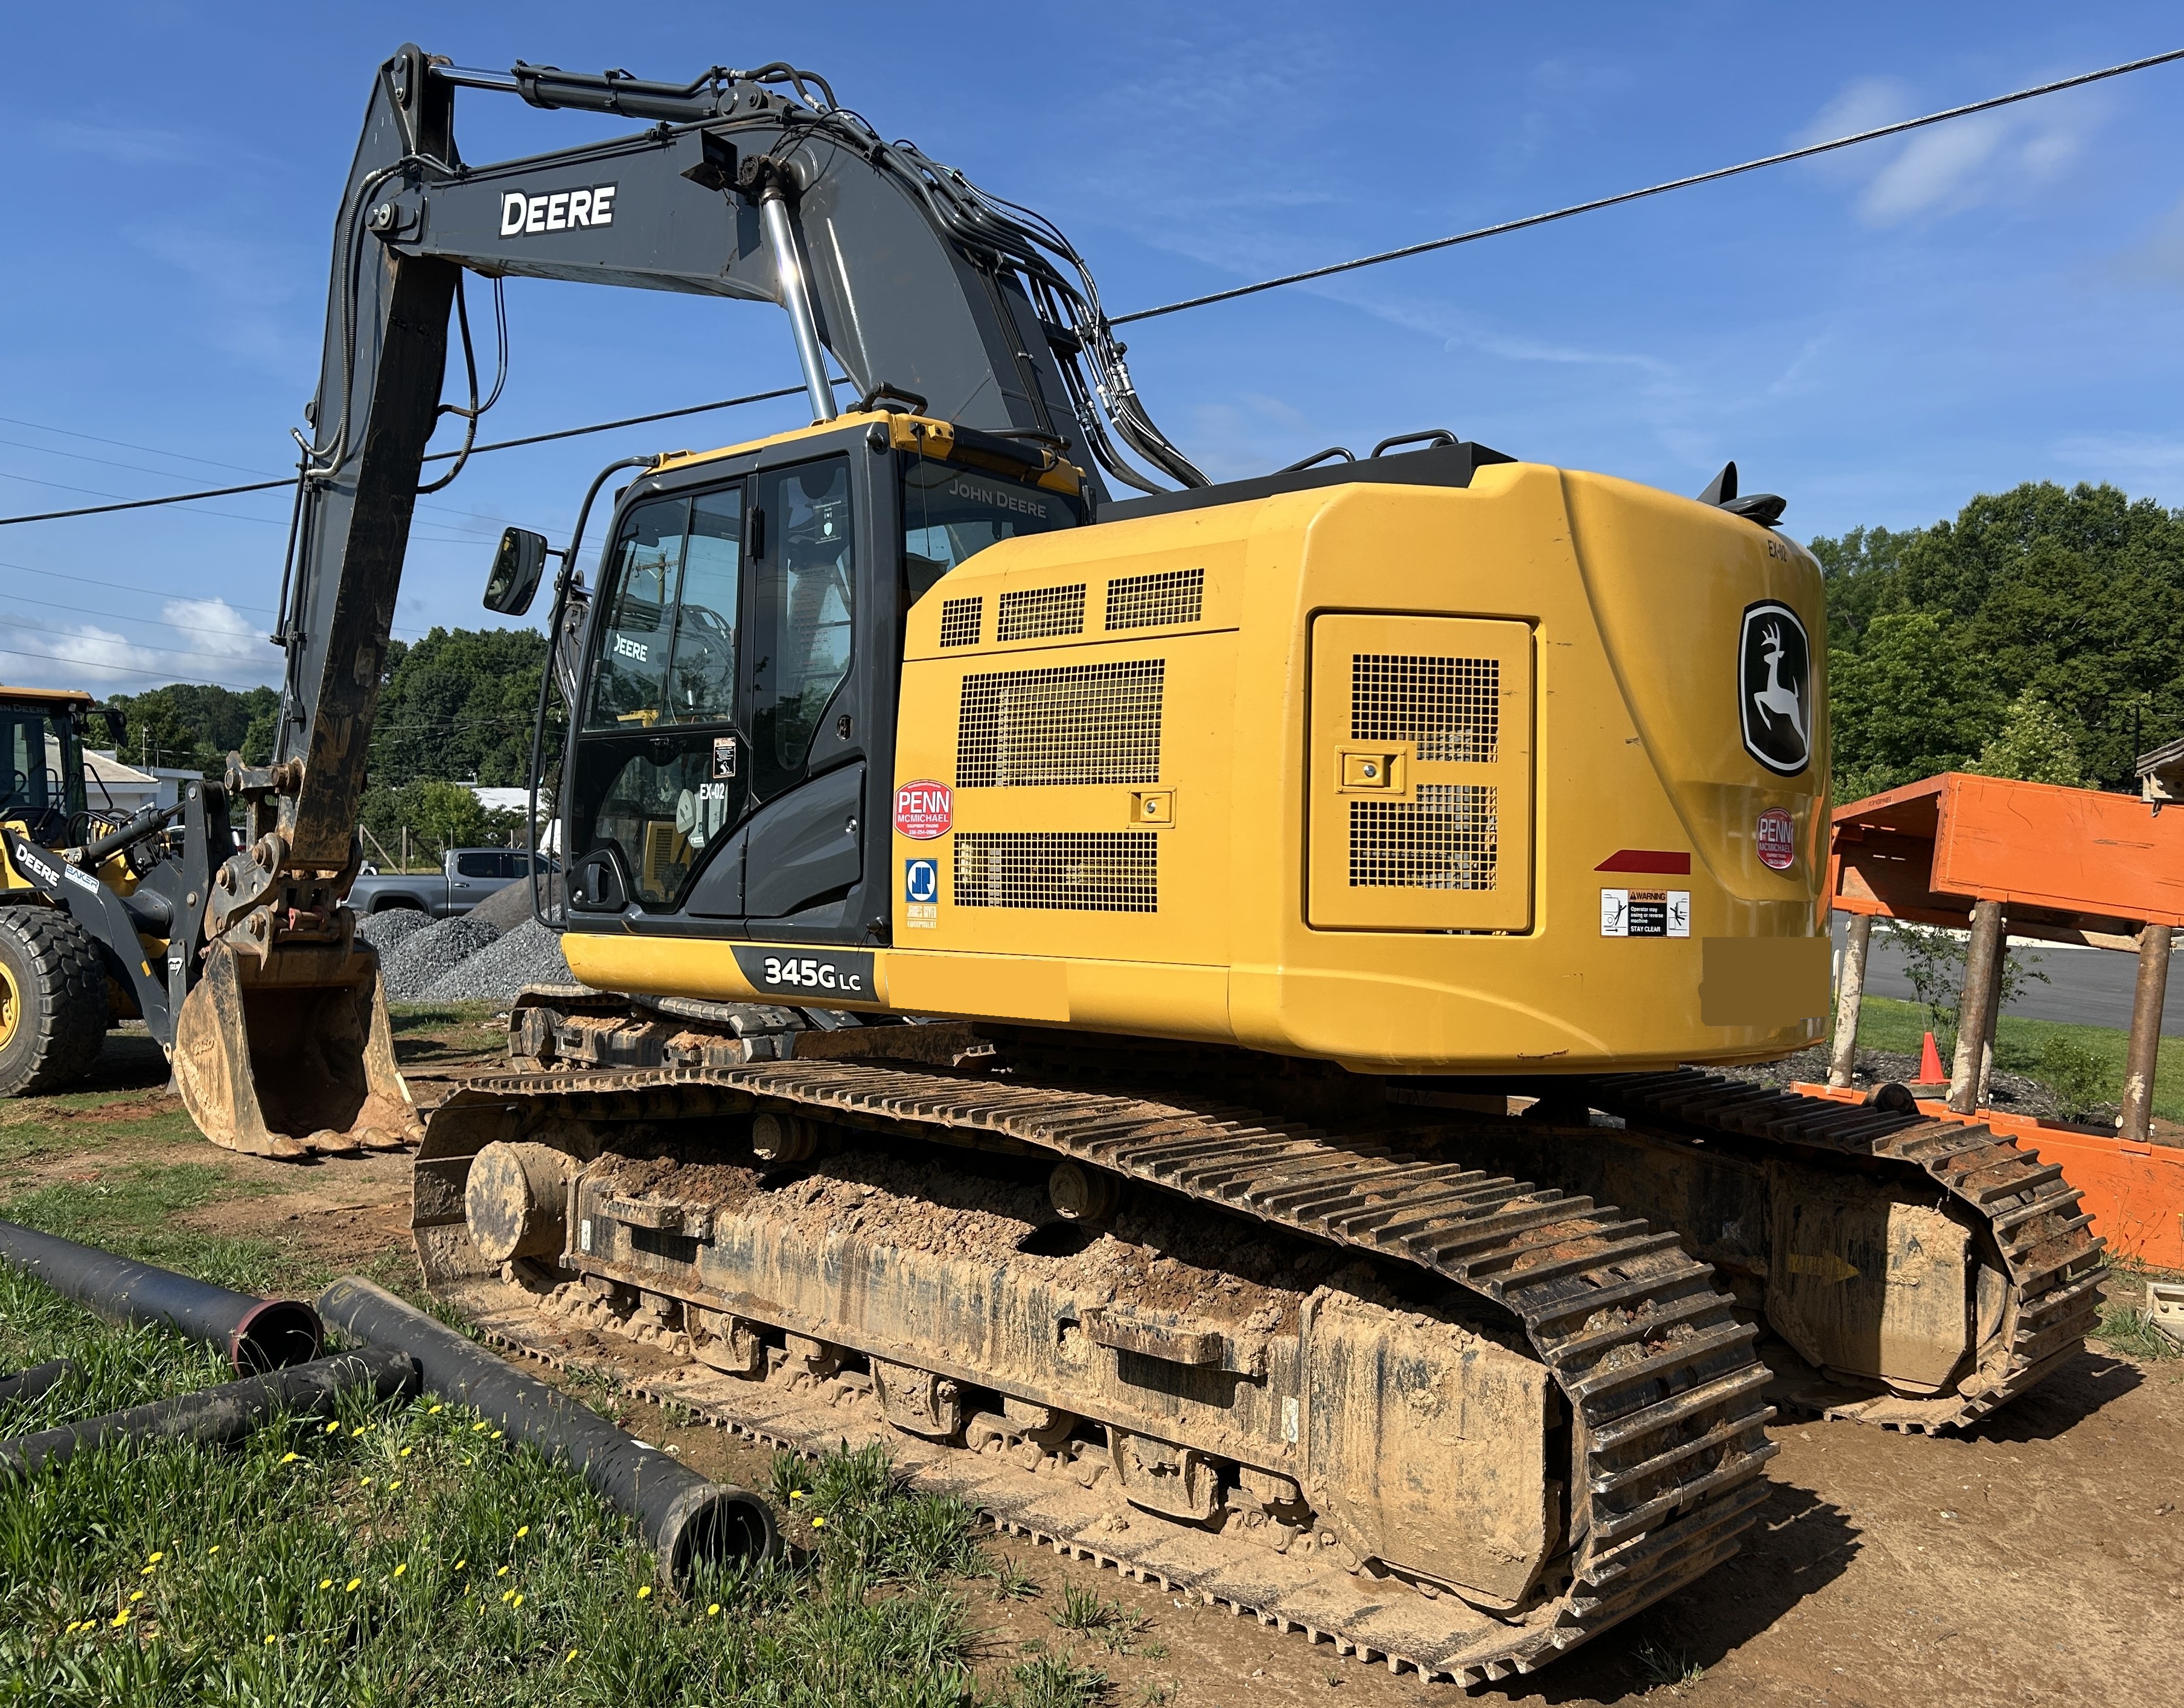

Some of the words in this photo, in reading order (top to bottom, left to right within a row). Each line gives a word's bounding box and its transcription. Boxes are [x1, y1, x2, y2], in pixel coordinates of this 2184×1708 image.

[500, 186, 616, 236] DEERE
[949, 479, 992, 505] JOHN
[997, 491, 1047, 519] DEERE
[13, 703, 51, 714] DEERE
[700, 782, 725, 800] EX-02
[898, 790, 950, 814] PENN
[898, 814, 950, 823] MCMICHAEL
[1760, 818, 1792, 843] PENN
[1759, 842, 1792, 853] MCMICHAEL
[16, 843, 60, 888] DEERE
[1636, 892, 1665, 901] WARNING
[764, 958, 836, 988] 345G
[839, 974, 861, 991] LC
